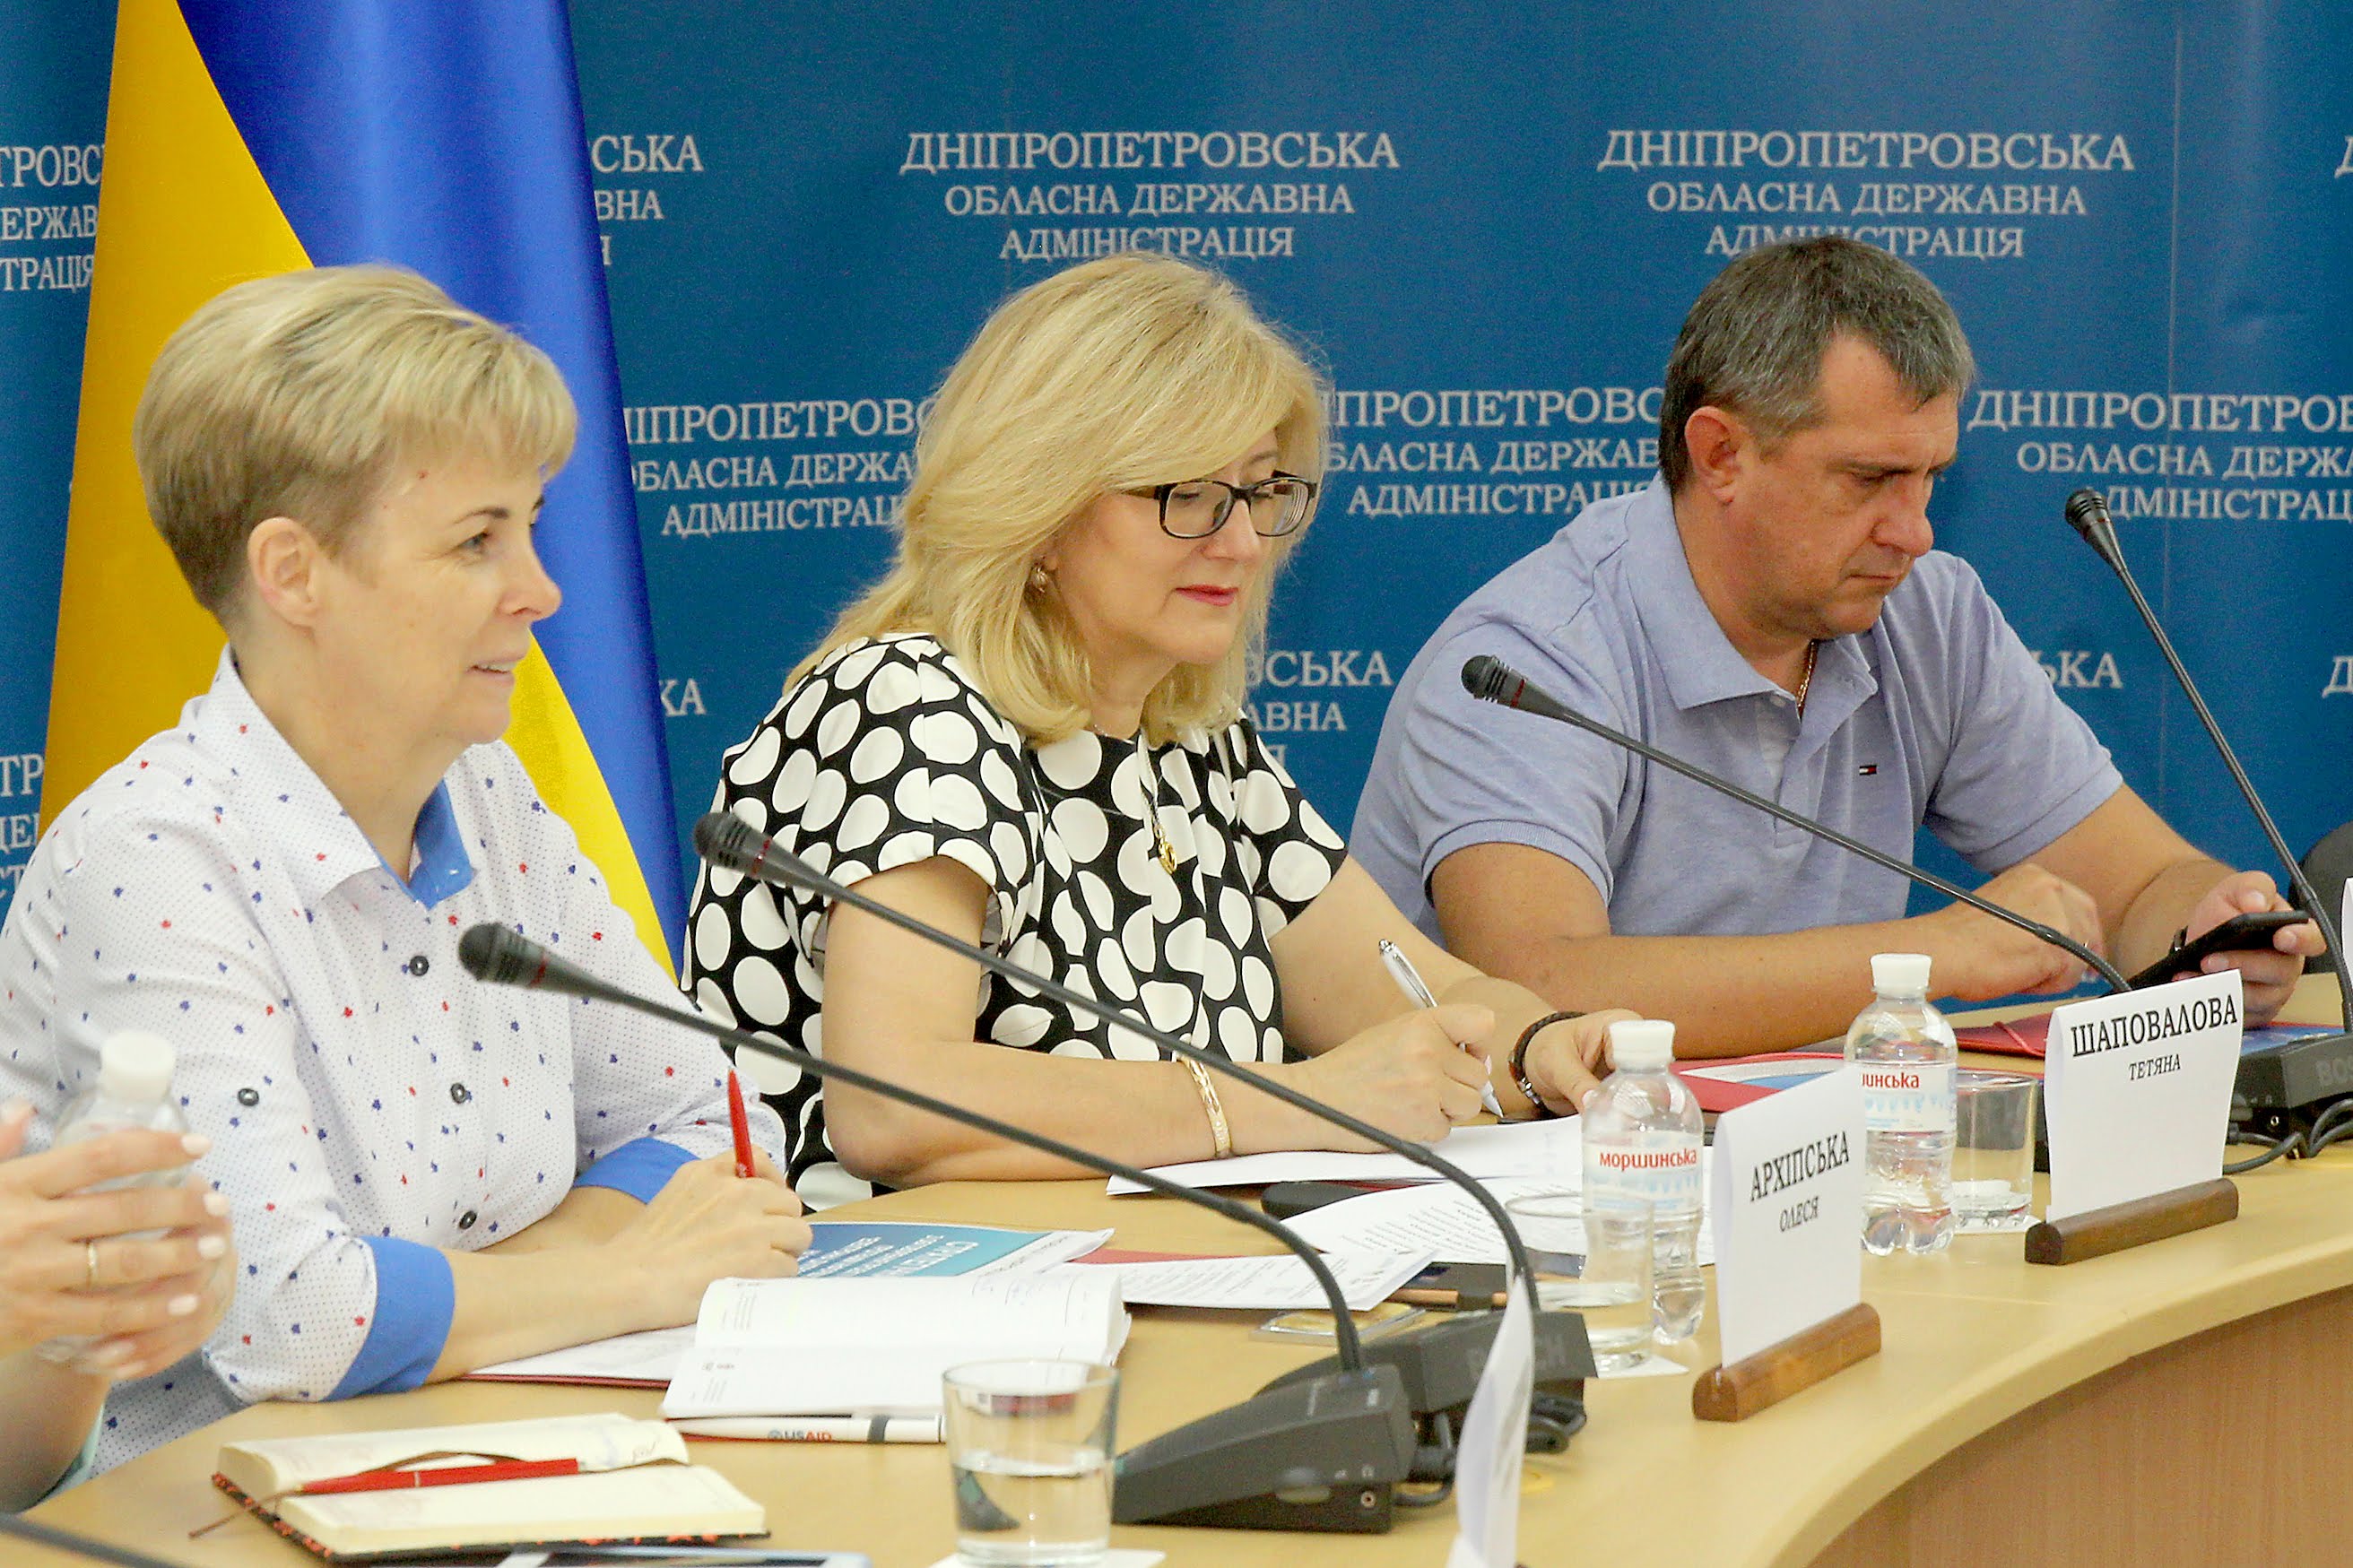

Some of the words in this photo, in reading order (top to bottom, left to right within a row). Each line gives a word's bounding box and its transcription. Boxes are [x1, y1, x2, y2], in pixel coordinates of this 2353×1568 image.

[590, 134, 705, 173] СЬКА
[898, 131, 1401, 177] ДНІПРОПЕТРОВСЬКА
[1596, 129, 2135, 173] ДНІПРОПЕТРОВСЬКА
[944, 183, 1121, 216] ОБЛАСНА
[1127, 182, 1356, 218] ДЕРЖАВНА
[1646, 181, 1842, 212] ОБЛАСНА
[1851, 182, 2088, 217] ДЕРЖАВНА
[631, 455, 777, 492] БЛАСНА
[2016, 440, 2214, 478] ОБЛАСНА
[2221, 445, 2353, 481] ДЕРЖ
[2104, 485, 2353, 524] ДМІНІСТРАЦ
[2071, 993, 2238, 1058] ШАПОВАЛОВА
[1861, 1070, 1920, 1089] инська
[2129, 1053, 2182, 1082] ТЕТЯНА
[1599, 1148, 1697, 1172] моршинська
[1750, 1131, 1851, 1202] АРХІПСЬКА
[1779, 1195, 1820, 1234] ОЛЕСЯ
